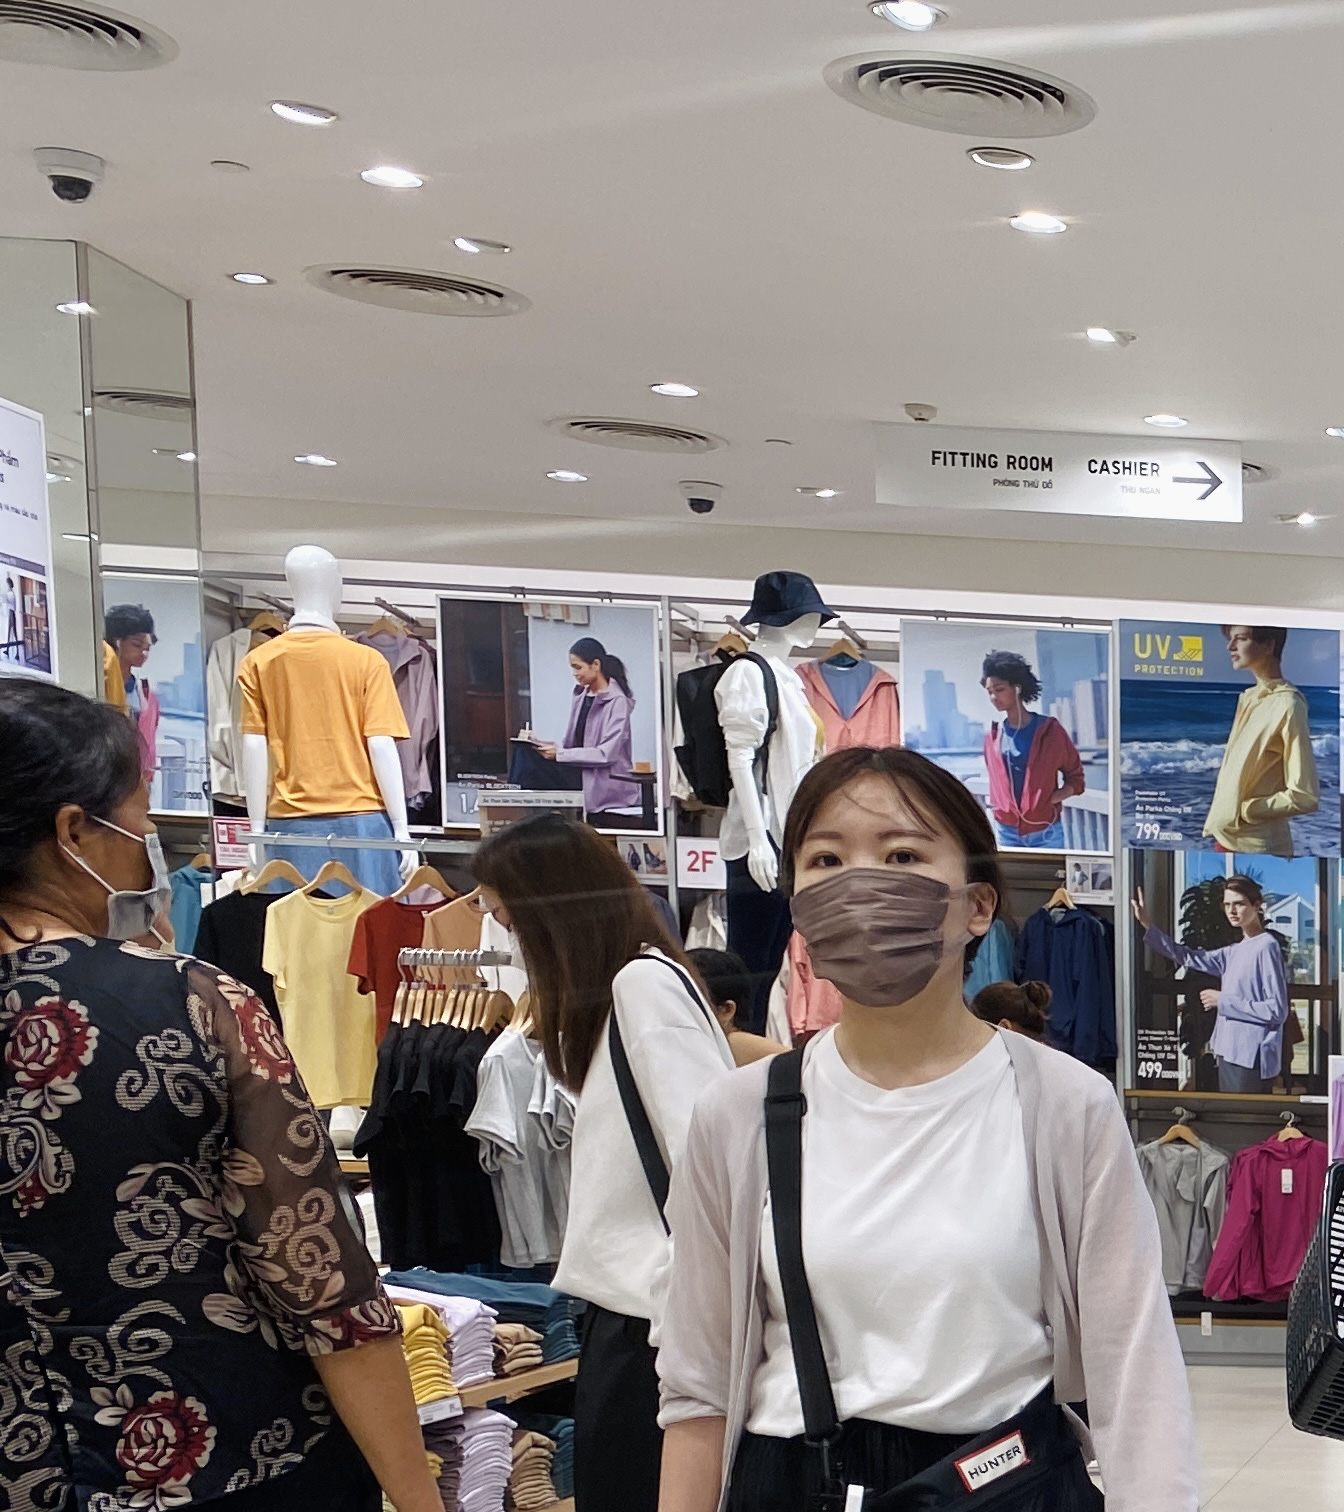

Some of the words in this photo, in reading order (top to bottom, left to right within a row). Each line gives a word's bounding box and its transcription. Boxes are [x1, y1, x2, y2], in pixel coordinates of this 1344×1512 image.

[931, 450, 998, 468] FITTING
[1007, 454, 1053, 472] ROOM
[1088, 459, 1160, 477] CASHIER
[1134, 633, 1171, 660] UV
[1134, 664, 1203, 676] PROTECTION
[1136, 822, 1159, 840] 799
[687, 850, 717, 872] 2F
[1137, 1061, 1163, 1079] 499
[967, 1445, 1022, 1480] HUNTER
